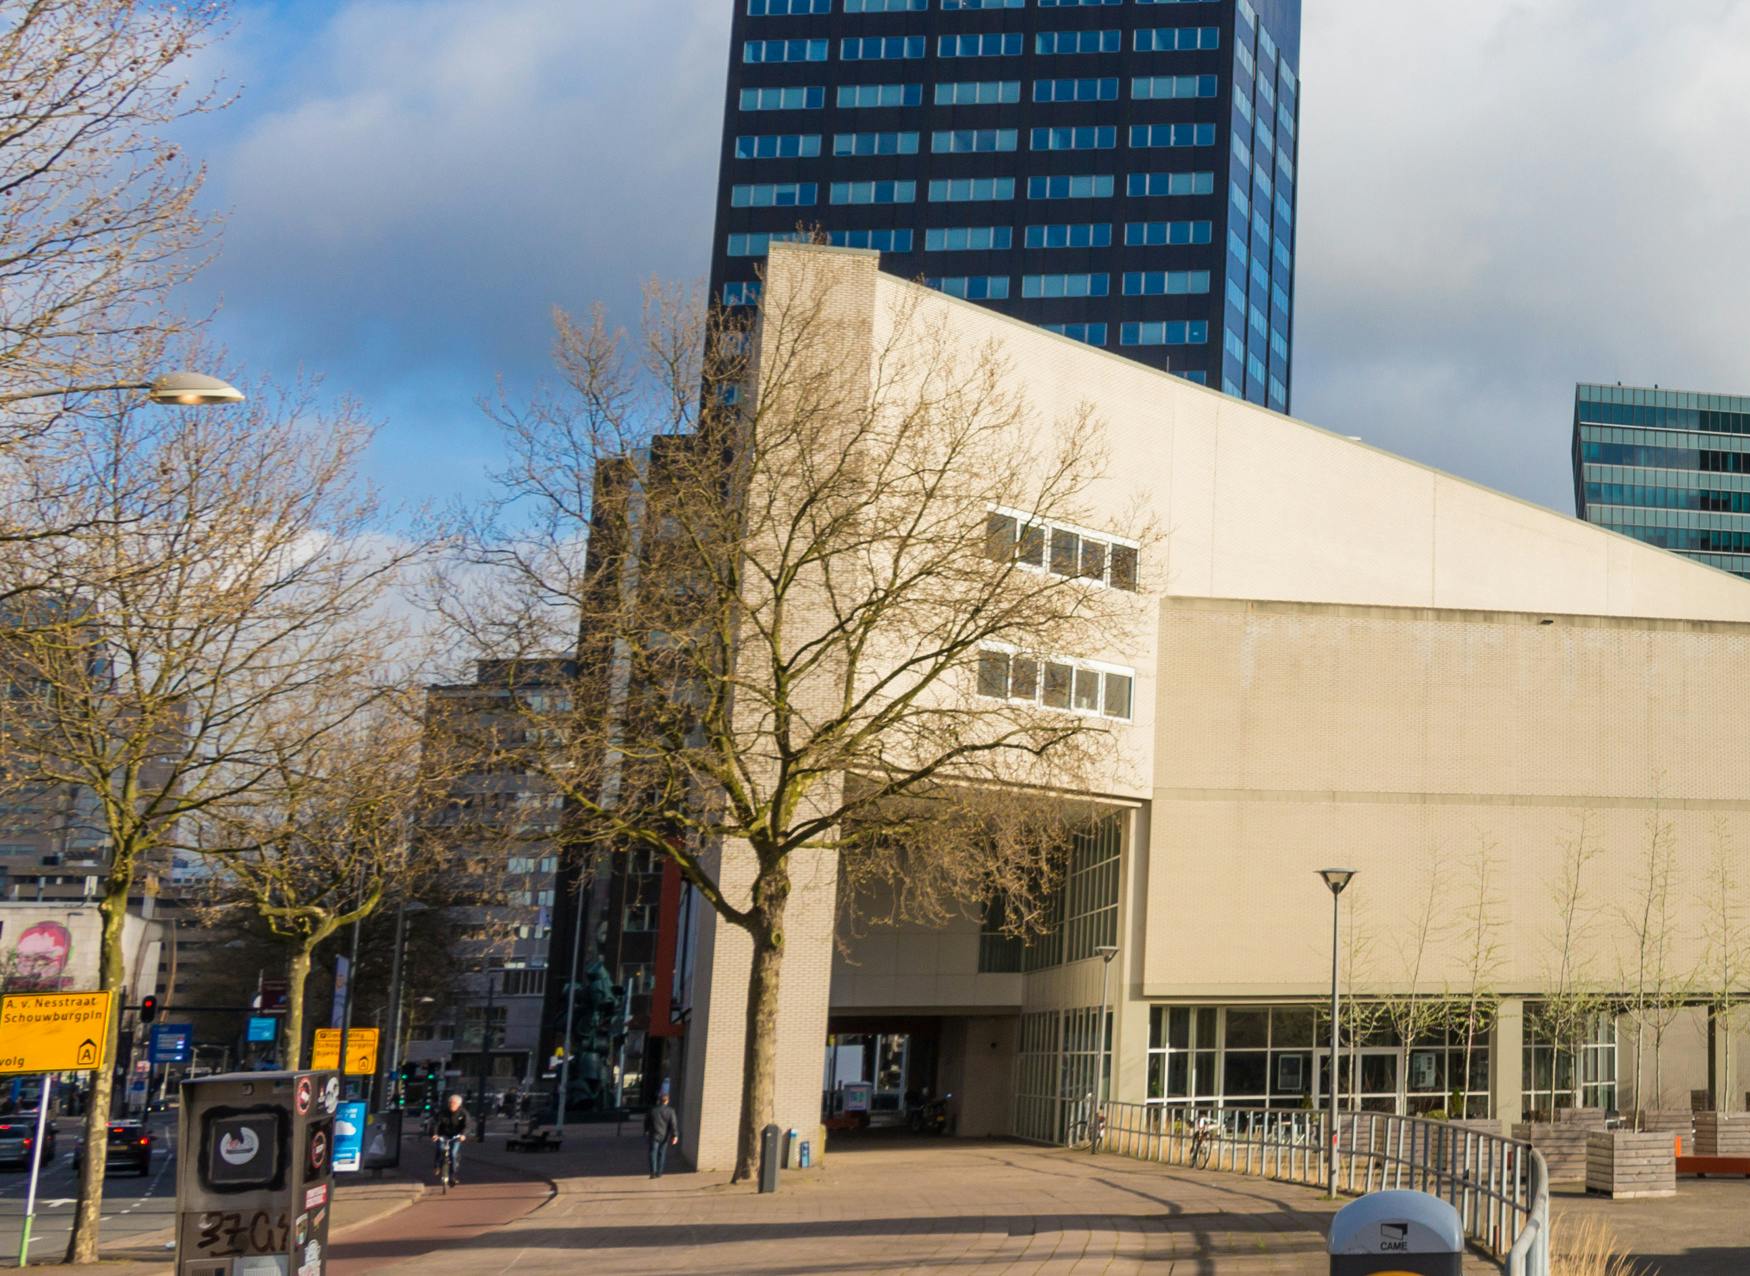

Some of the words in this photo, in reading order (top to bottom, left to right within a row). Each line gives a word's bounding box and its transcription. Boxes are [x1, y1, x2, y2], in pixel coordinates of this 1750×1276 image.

[35, 997, 97, 1009] Nesstraat
[4, 1010, 103, 1024] Schouwburgpln
[82, 1049, 91, 1061] A
[1380, 1241, 1409, 1251] CAME
